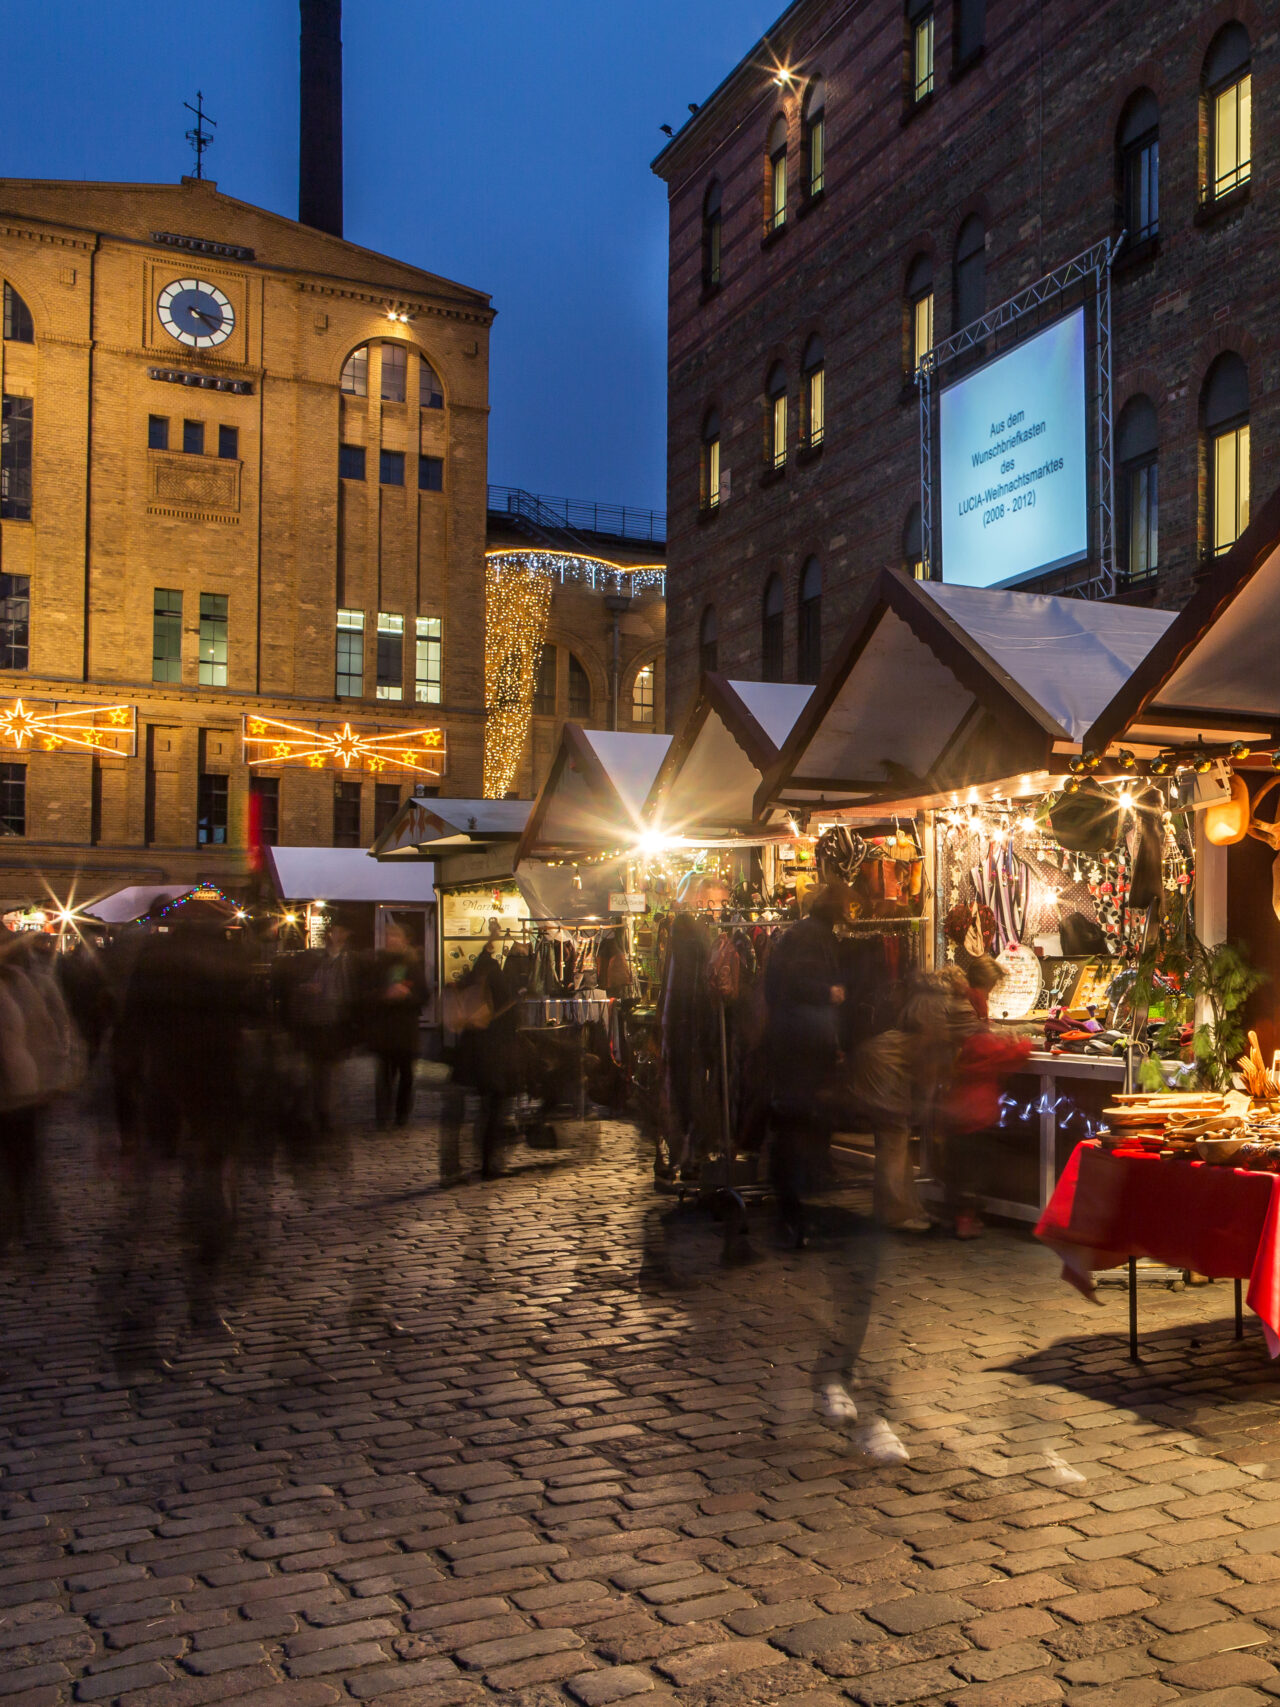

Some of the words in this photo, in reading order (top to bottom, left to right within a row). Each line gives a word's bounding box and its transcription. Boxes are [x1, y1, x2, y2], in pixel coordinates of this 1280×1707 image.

[990, 421, 1005, 438] Aus
[1007, 410, 1025, 429] dem
[971, 421, 1046, 467] Wunschbriefkasten
[1000, 458, 1015, 475] des
[958, 457, 1064, 516] LUCIA-Weihnachtsmarktes
[982, 504, 1005, 528] (2008
[1012, 489, 1036, 513] 2012)
